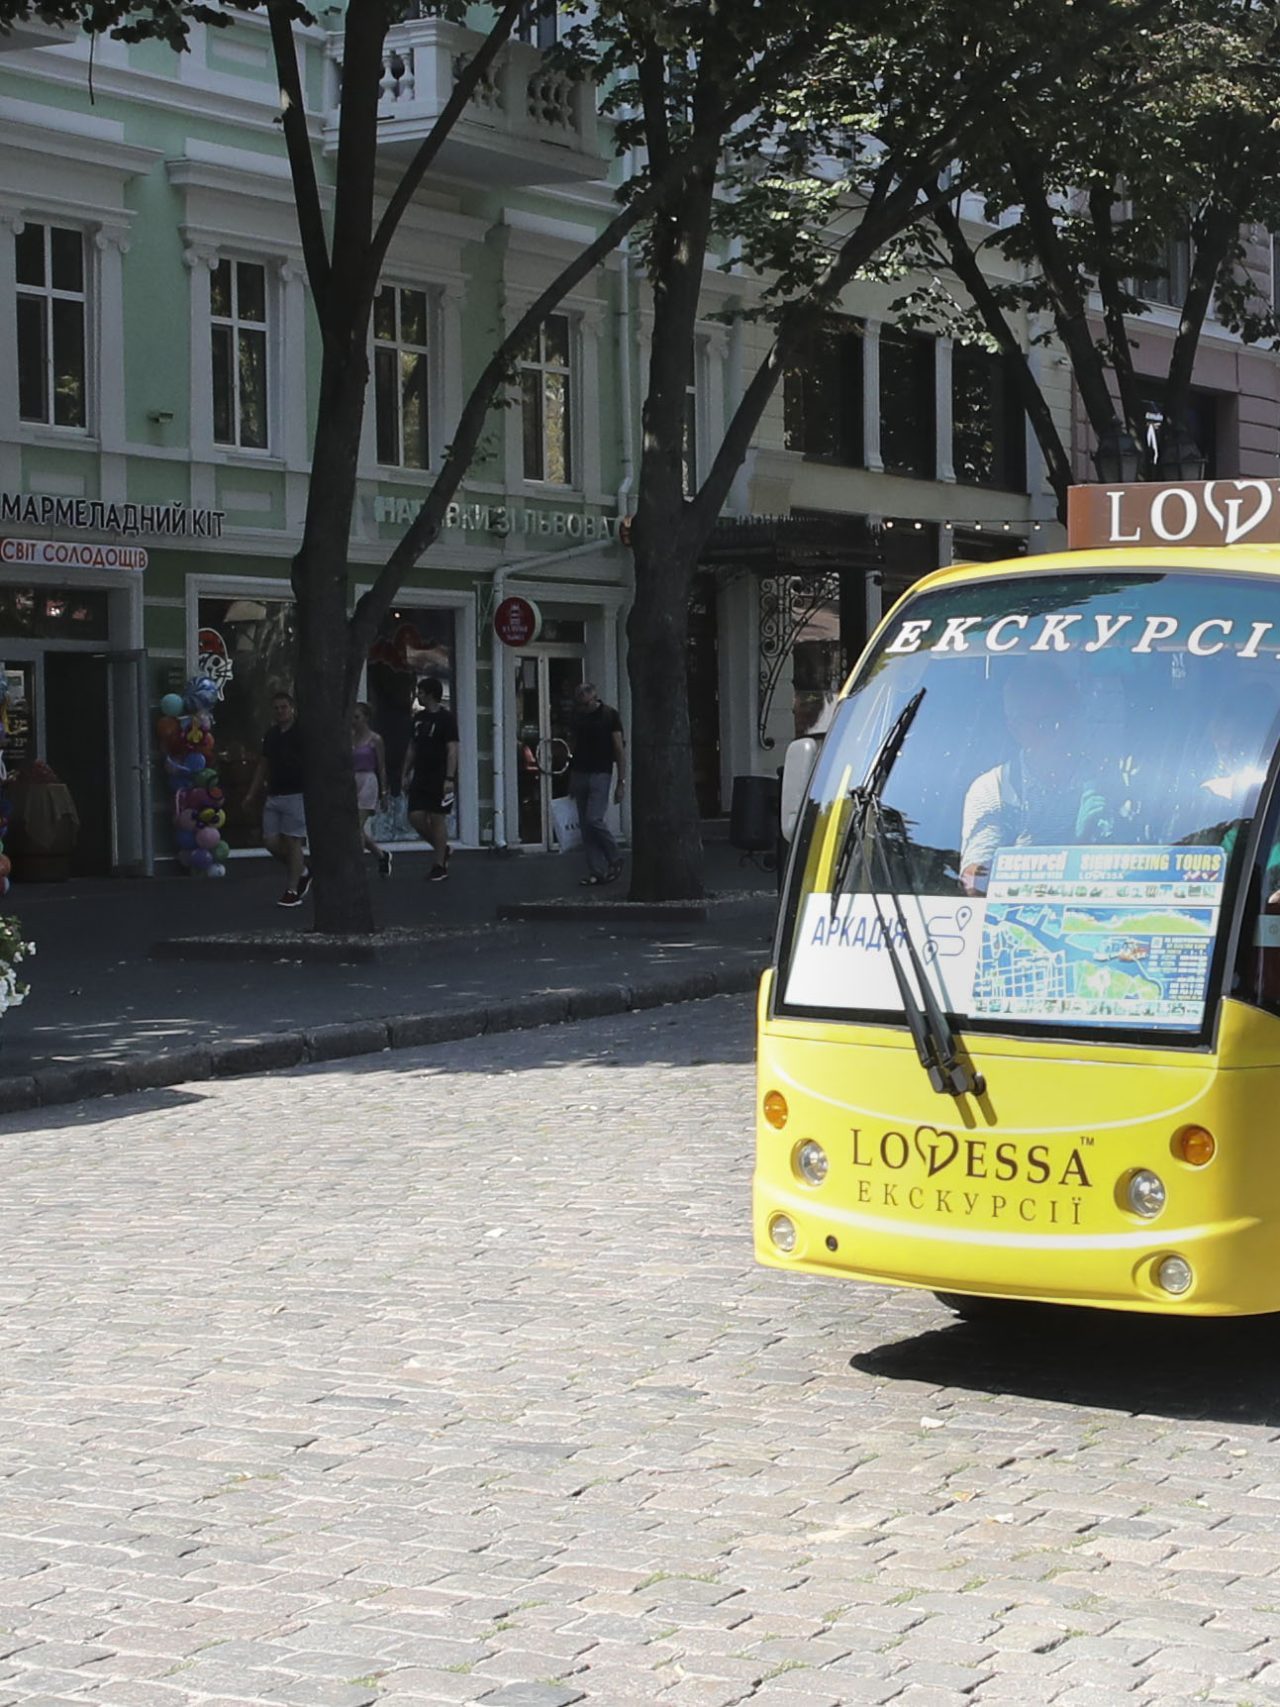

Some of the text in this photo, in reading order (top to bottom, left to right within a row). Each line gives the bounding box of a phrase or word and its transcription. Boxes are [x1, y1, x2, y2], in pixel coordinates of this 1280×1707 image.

[1, 493, 225, 537] МАРМЕЛАДНИЙ КІТ
[524, 509, 613, 540] ЛЬВОВА
[3, 541, 146, 569] СВІТ СОЛОДОЩІВ
[1176, 854, 1221, 871] TOURS
[850, 1125, 1093, 1188] LOVESSA
[857, 1179, 1082, 1226] ЕКСКУРСІЇ
